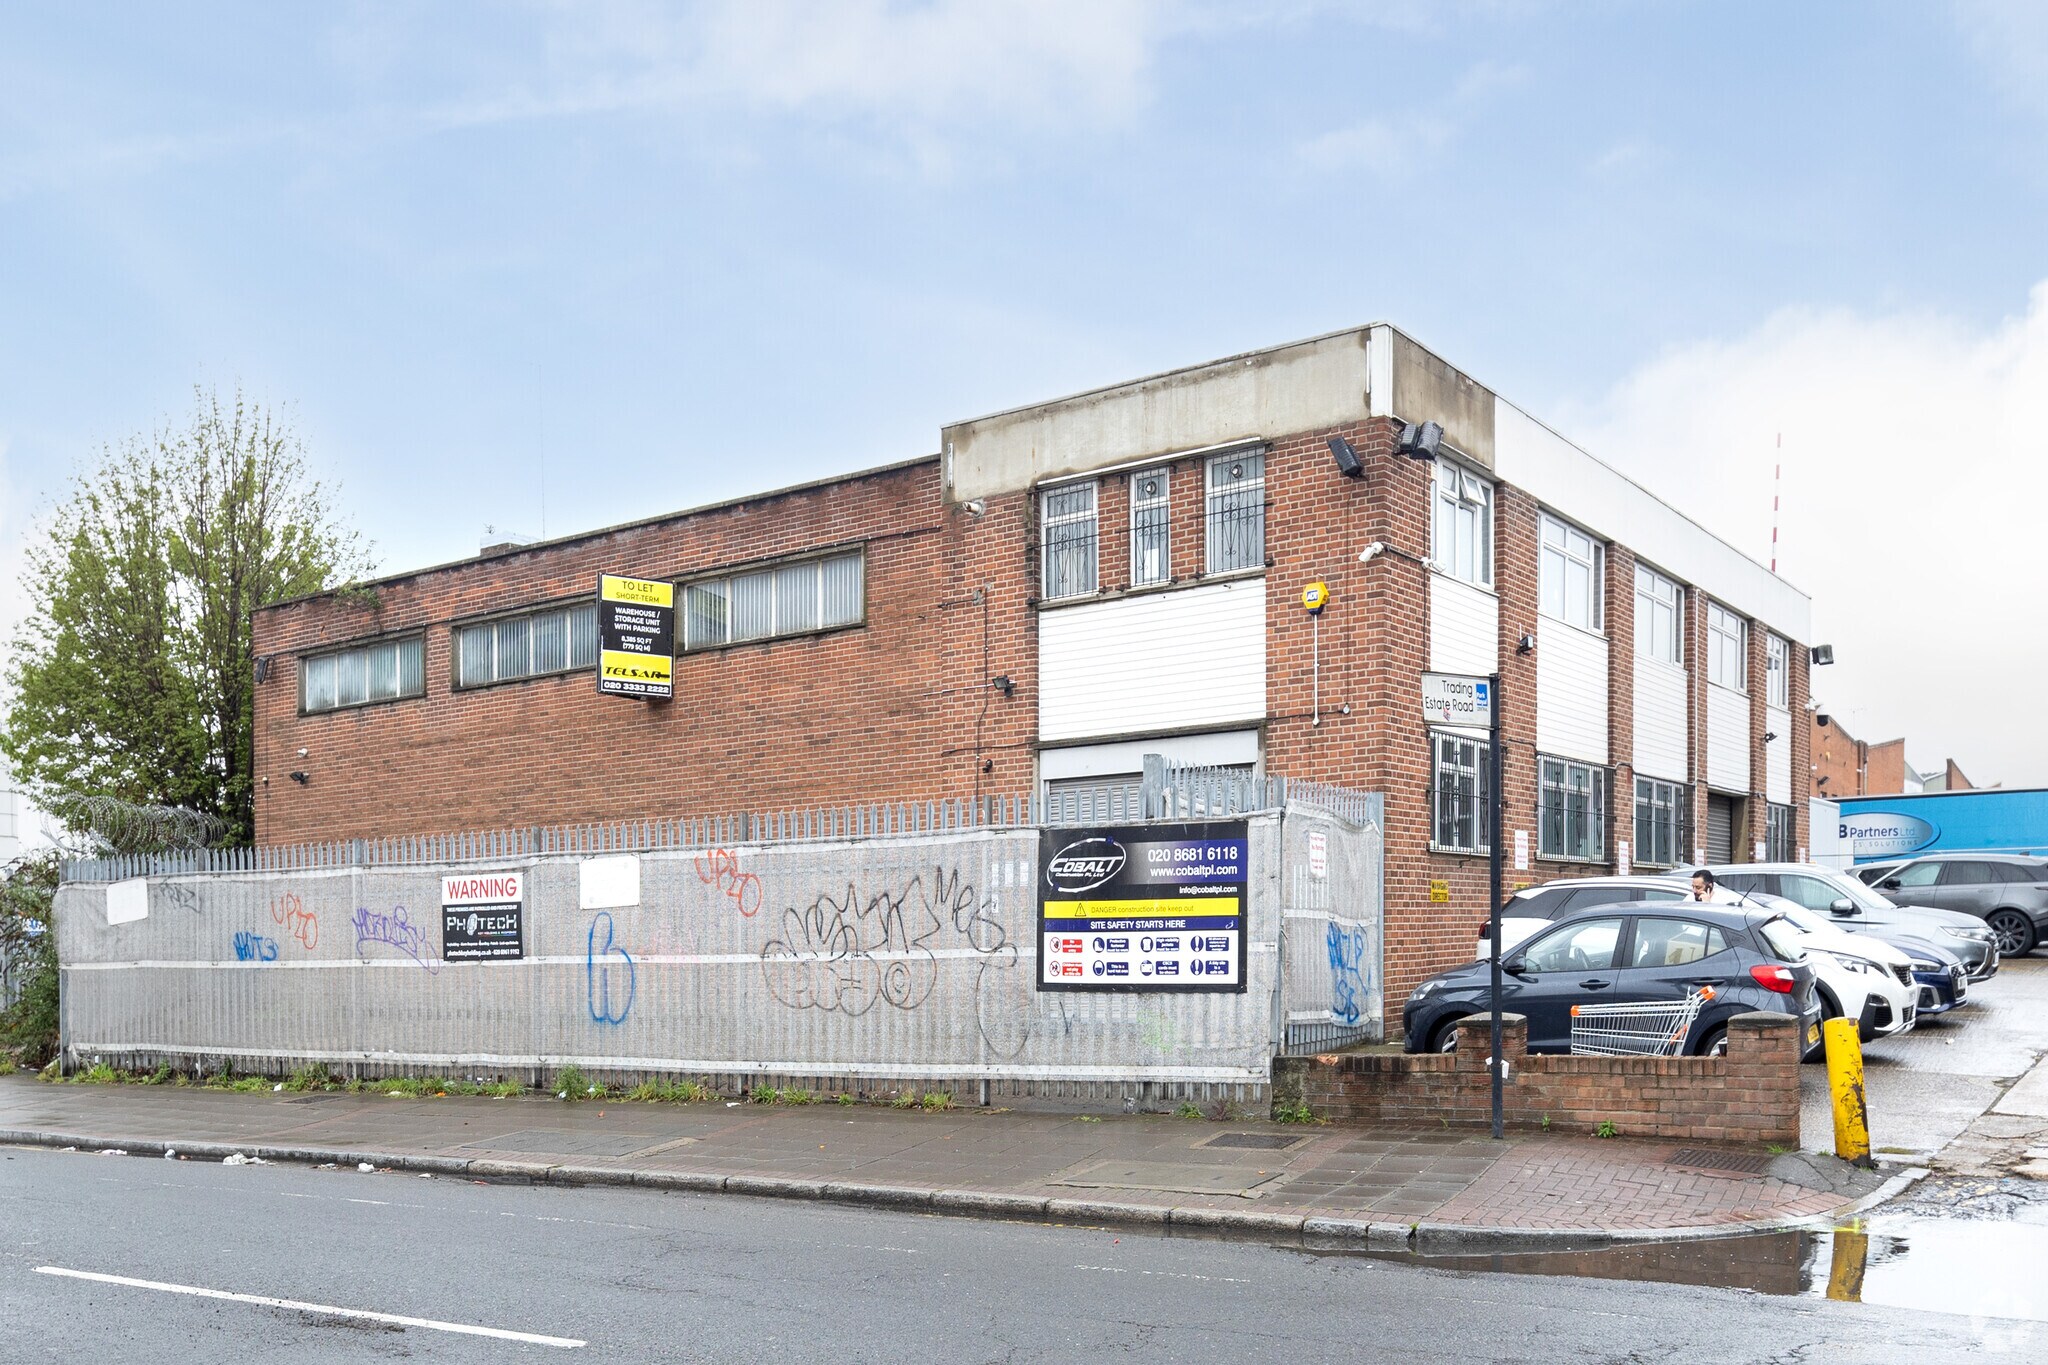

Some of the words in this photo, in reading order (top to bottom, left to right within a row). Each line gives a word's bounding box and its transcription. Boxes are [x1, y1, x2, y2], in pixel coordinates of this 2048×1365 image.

[622, 581, 634, 590] TO
[638, 583, 654, 592] LET
[616, 592, 659, 603] SHORT-TERM
[615, 607, 655, 618] WAREHOUSE
[615, 616, 644, 625] STORAGE
[633, 625, 660, 634] PARKING
[605, 667, 663, 679] TELSAR
[604, 682, 620, 690] 020
[623, 683, 646, 692] 3333
[647, 685, 669, 694] 2222
[1442, 680, 1472, 697] Trading
[1425, 696, 1450, 710] Estate
[1453, 699, 1473, 712] Road
[1850, 827, 1899, 838] Partners
[1148, 848, 1170, 862] 020
[1174, 848, 1203, 861] 8681
[1207, 846, 1238, 860] 6118
[1050, 856, 1124, 873] COBALT
[1150, 864, 1237, 878] www.cobaltpl.com
[448, 878, 517, 899] WARNING
[1179, 886, 1237, 895] info@cobaltpl.com
[1168, 905, 1181, 914] keep
[1107, 920, 1134, 929] SAFETY
[1135, 920, 1164, 928] STARTS
